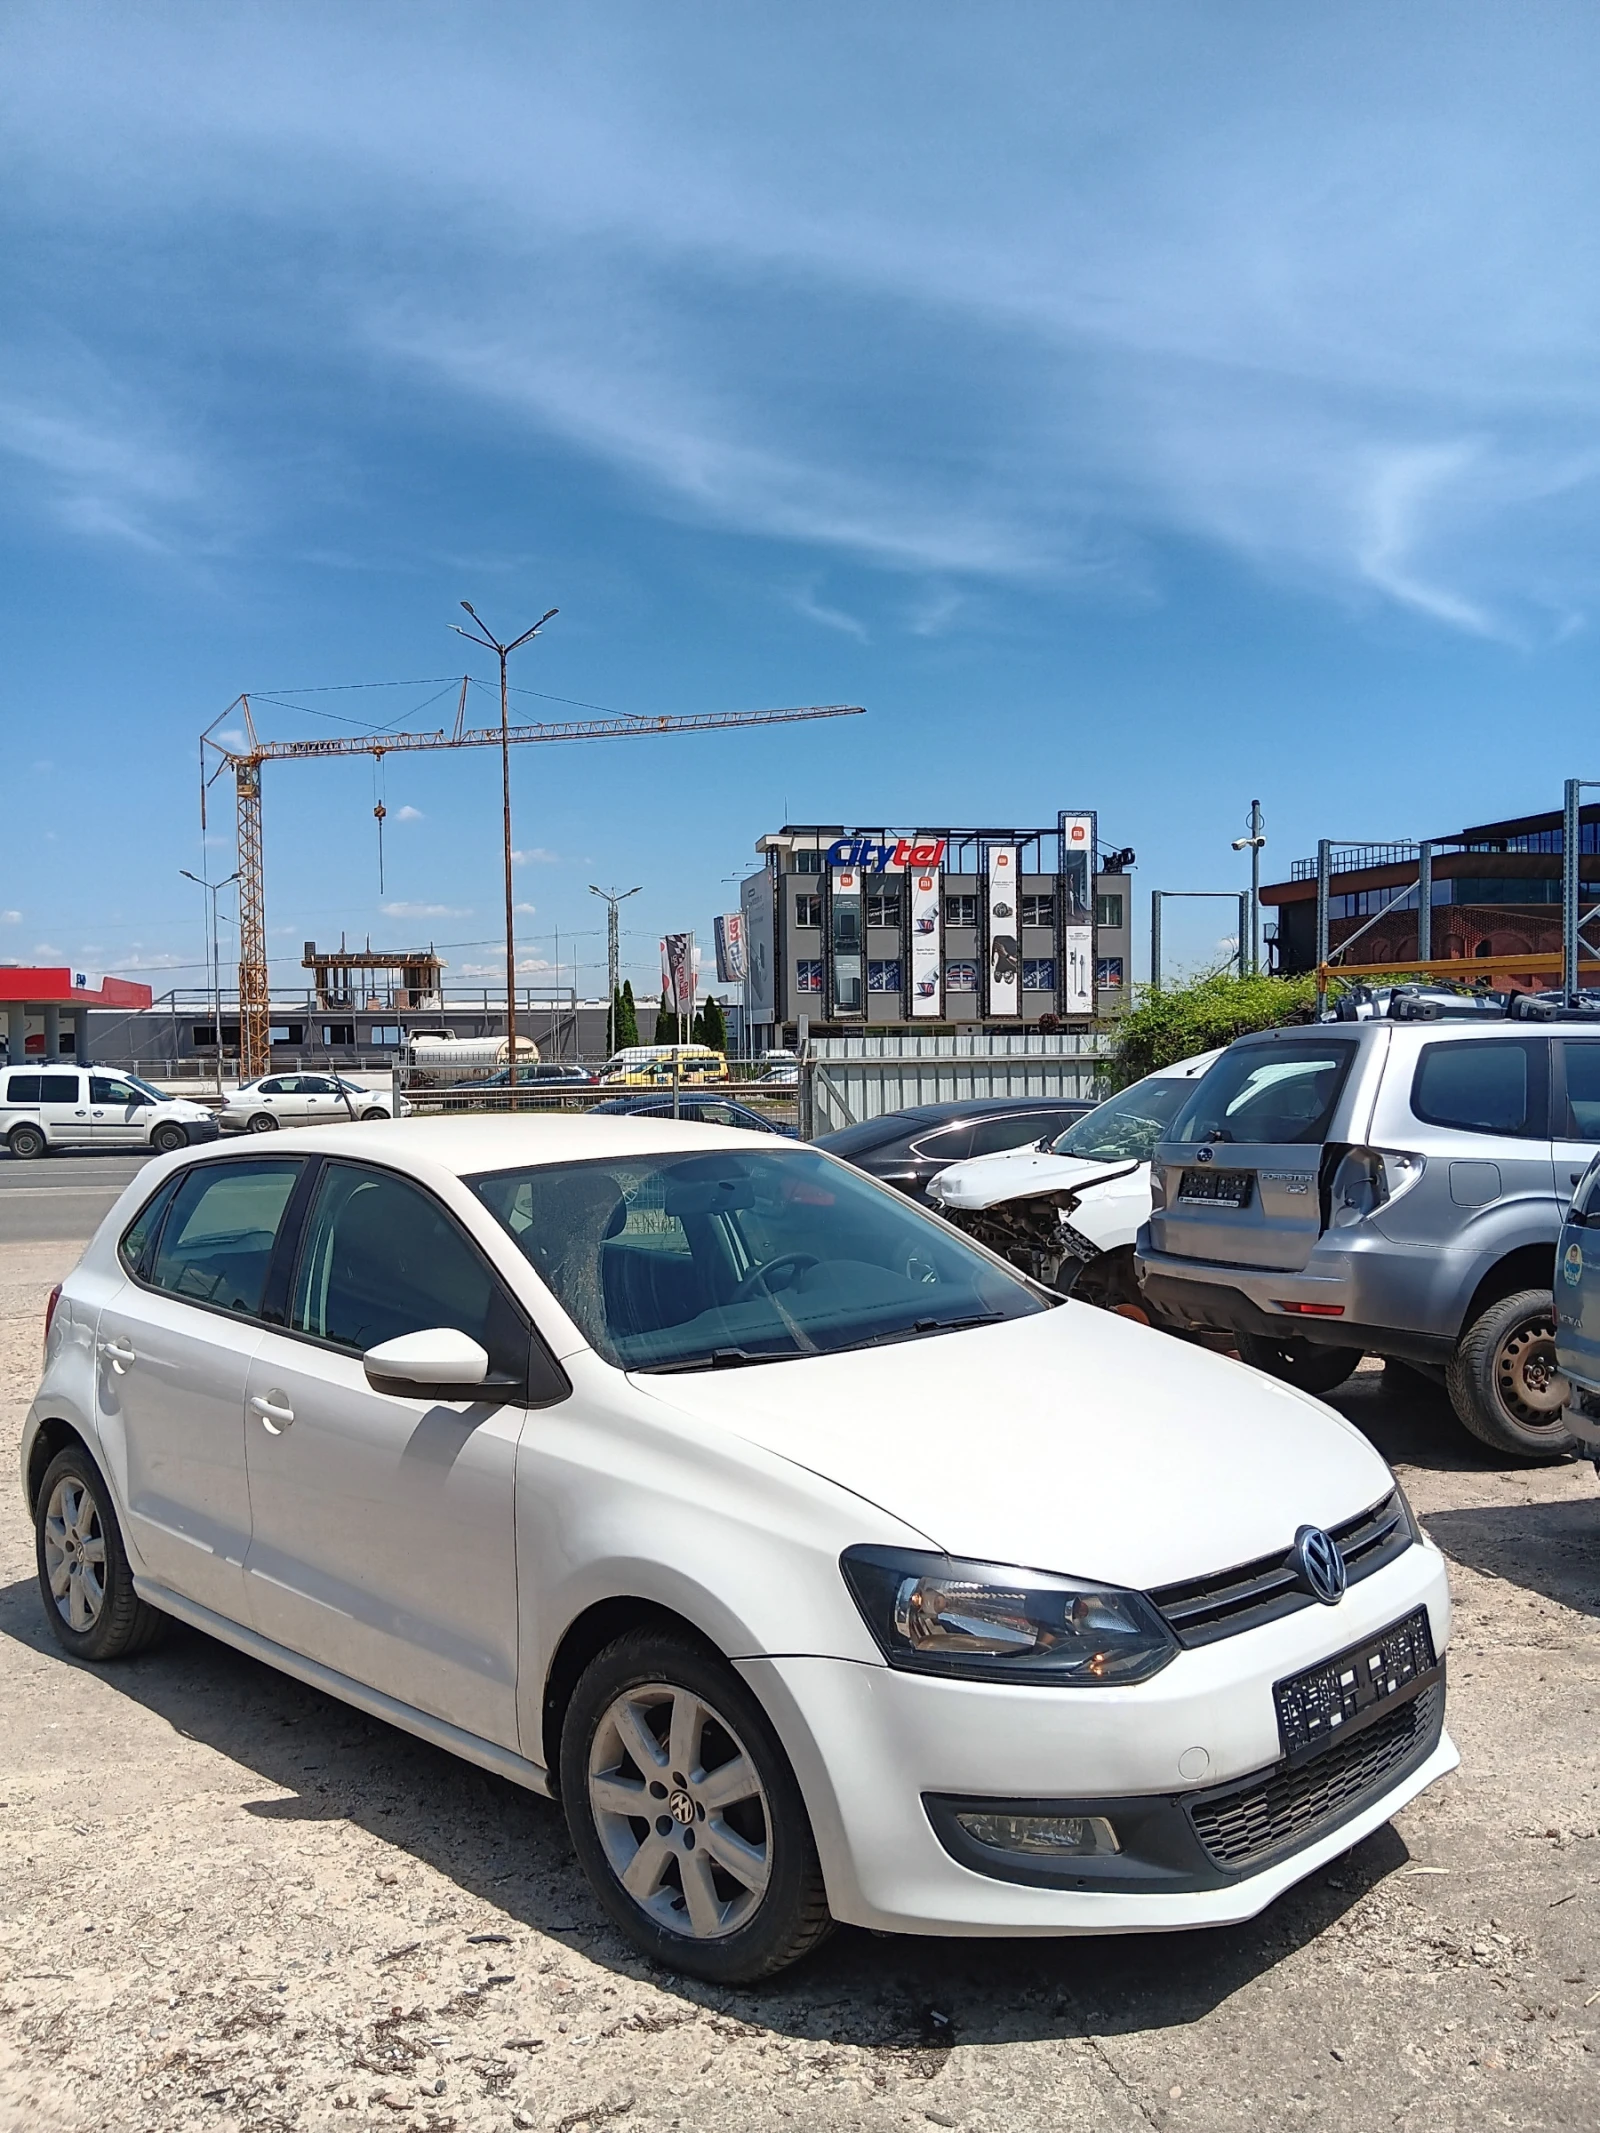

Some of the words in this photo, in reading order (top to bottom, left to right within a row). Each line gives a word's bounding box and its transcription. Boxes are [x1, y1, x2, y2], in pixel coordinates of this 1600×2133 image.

[827, 839, 946, 873] Citytel
[868, 962, 897, 985] МАТАЦИ
[1023, 961, 1050, 984] МАТАЦИ
[1261, 1173, 1313, 1182] FORESTER
